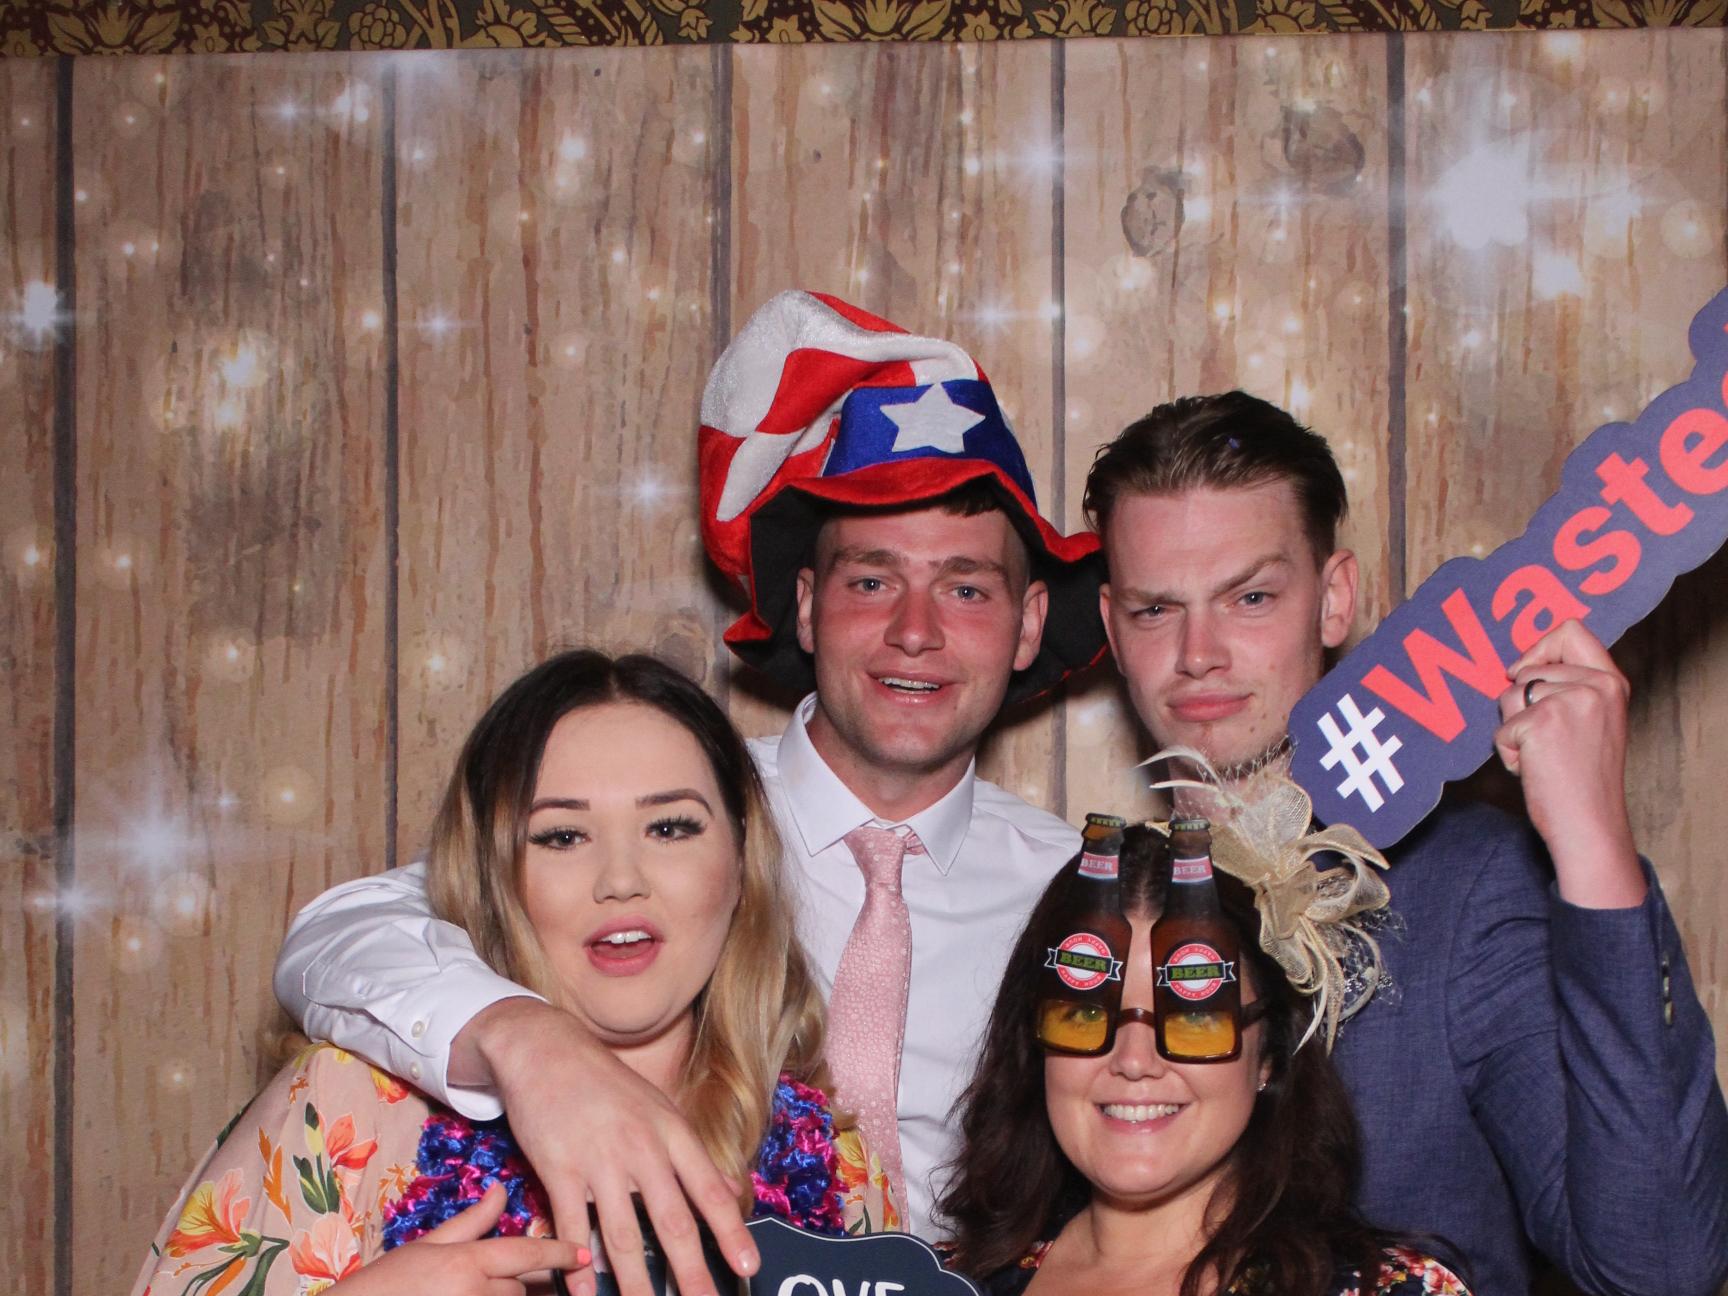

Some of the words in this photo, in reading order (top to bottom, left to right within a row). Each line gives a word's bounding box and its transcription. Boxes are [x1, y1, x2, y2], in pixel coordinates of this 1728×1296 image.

[1316, 323, 1728, 813] #Waste
[1080, 858, 1113, 871] BEER
[1173, 864, 1206, 875] BEER
[1060, 951, 1107, 973] BEER
[1170, 965, 1220, 979] BEER
